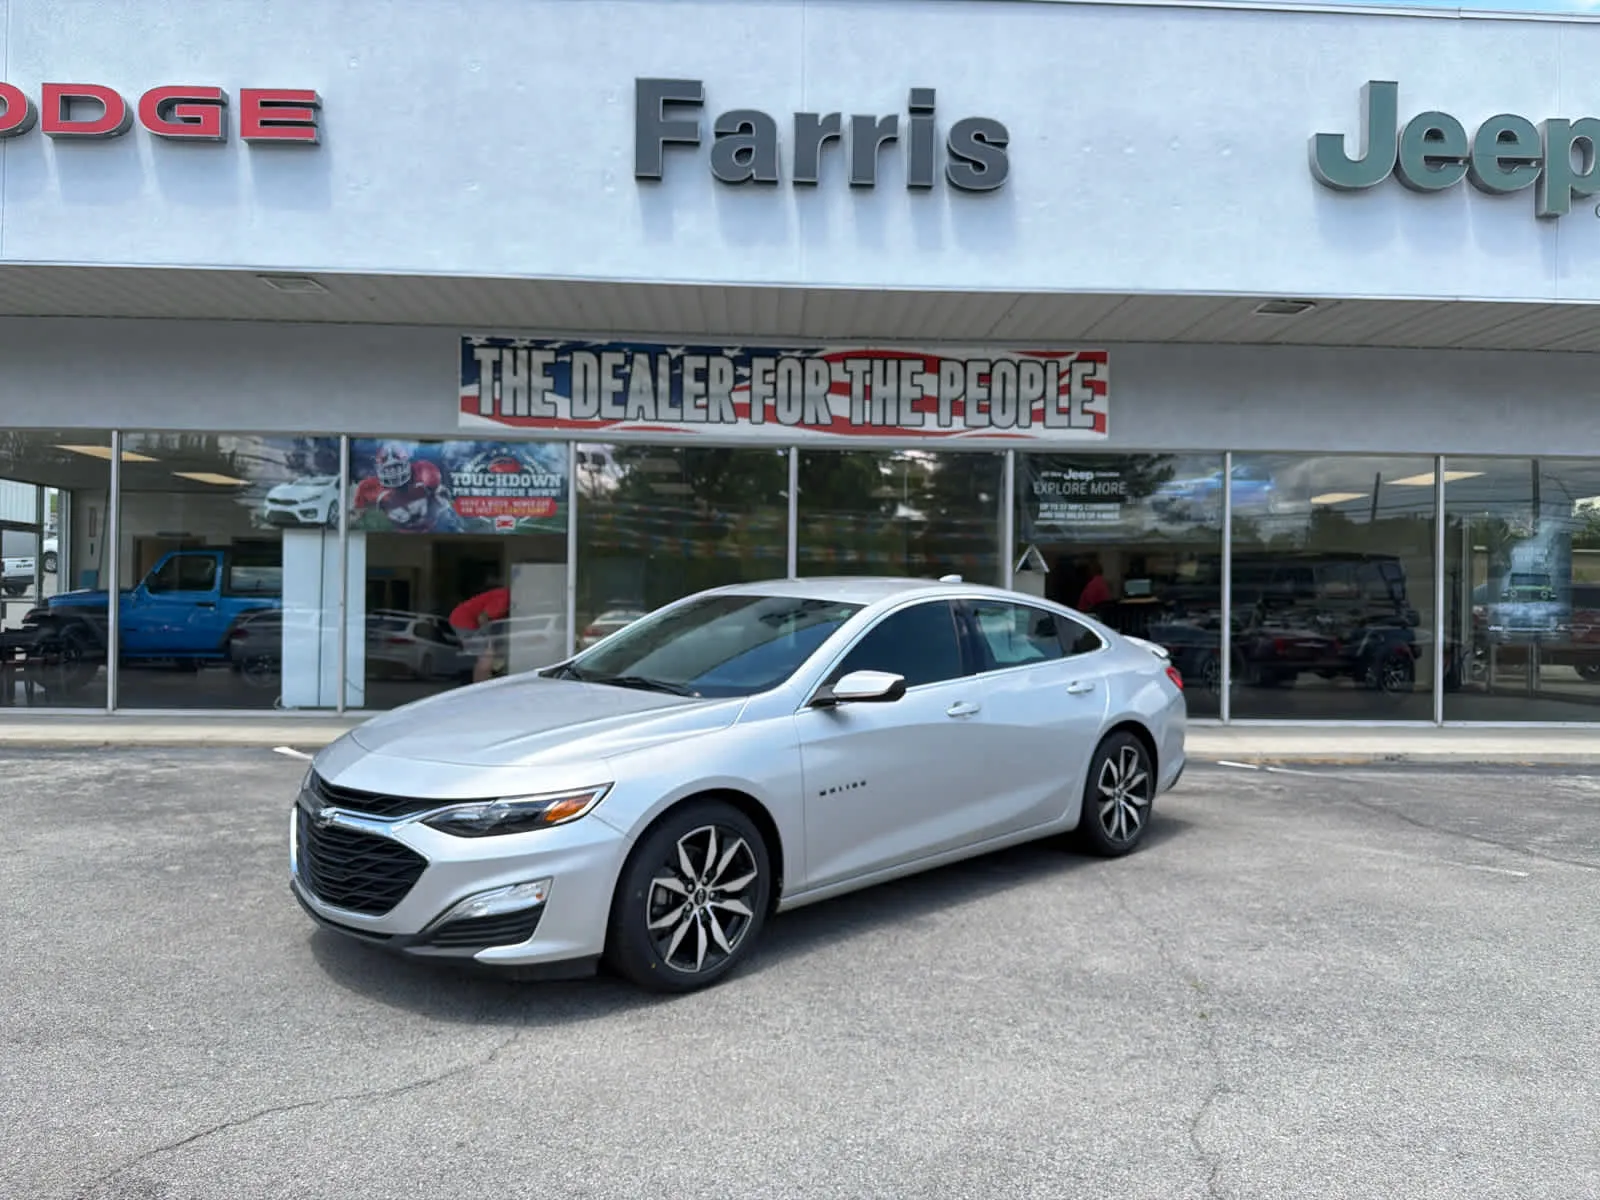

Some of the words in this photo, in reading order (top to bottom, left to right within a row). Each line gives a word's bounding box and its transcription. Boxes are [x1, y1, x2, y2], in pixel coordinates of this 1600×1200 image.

[635, 77, 1010, 191] Farris
[1308, 80, 1600, 219] Jeep
[474, 347, 558, 418] THE
[569, 350, 738, 424] DEALER
[750, 354, 832, 427] FOR
[843, 357, 925, 428] THE
[936, 358, 1097, 430] PEOPLE
[450, 471, 561, 487] TOUCHDOWN
[1033, 481, 1088, 495] EXPLORE
[1090, 481, 1128, 495] MORE
[1063, 468, 1095, 482] Jeep
